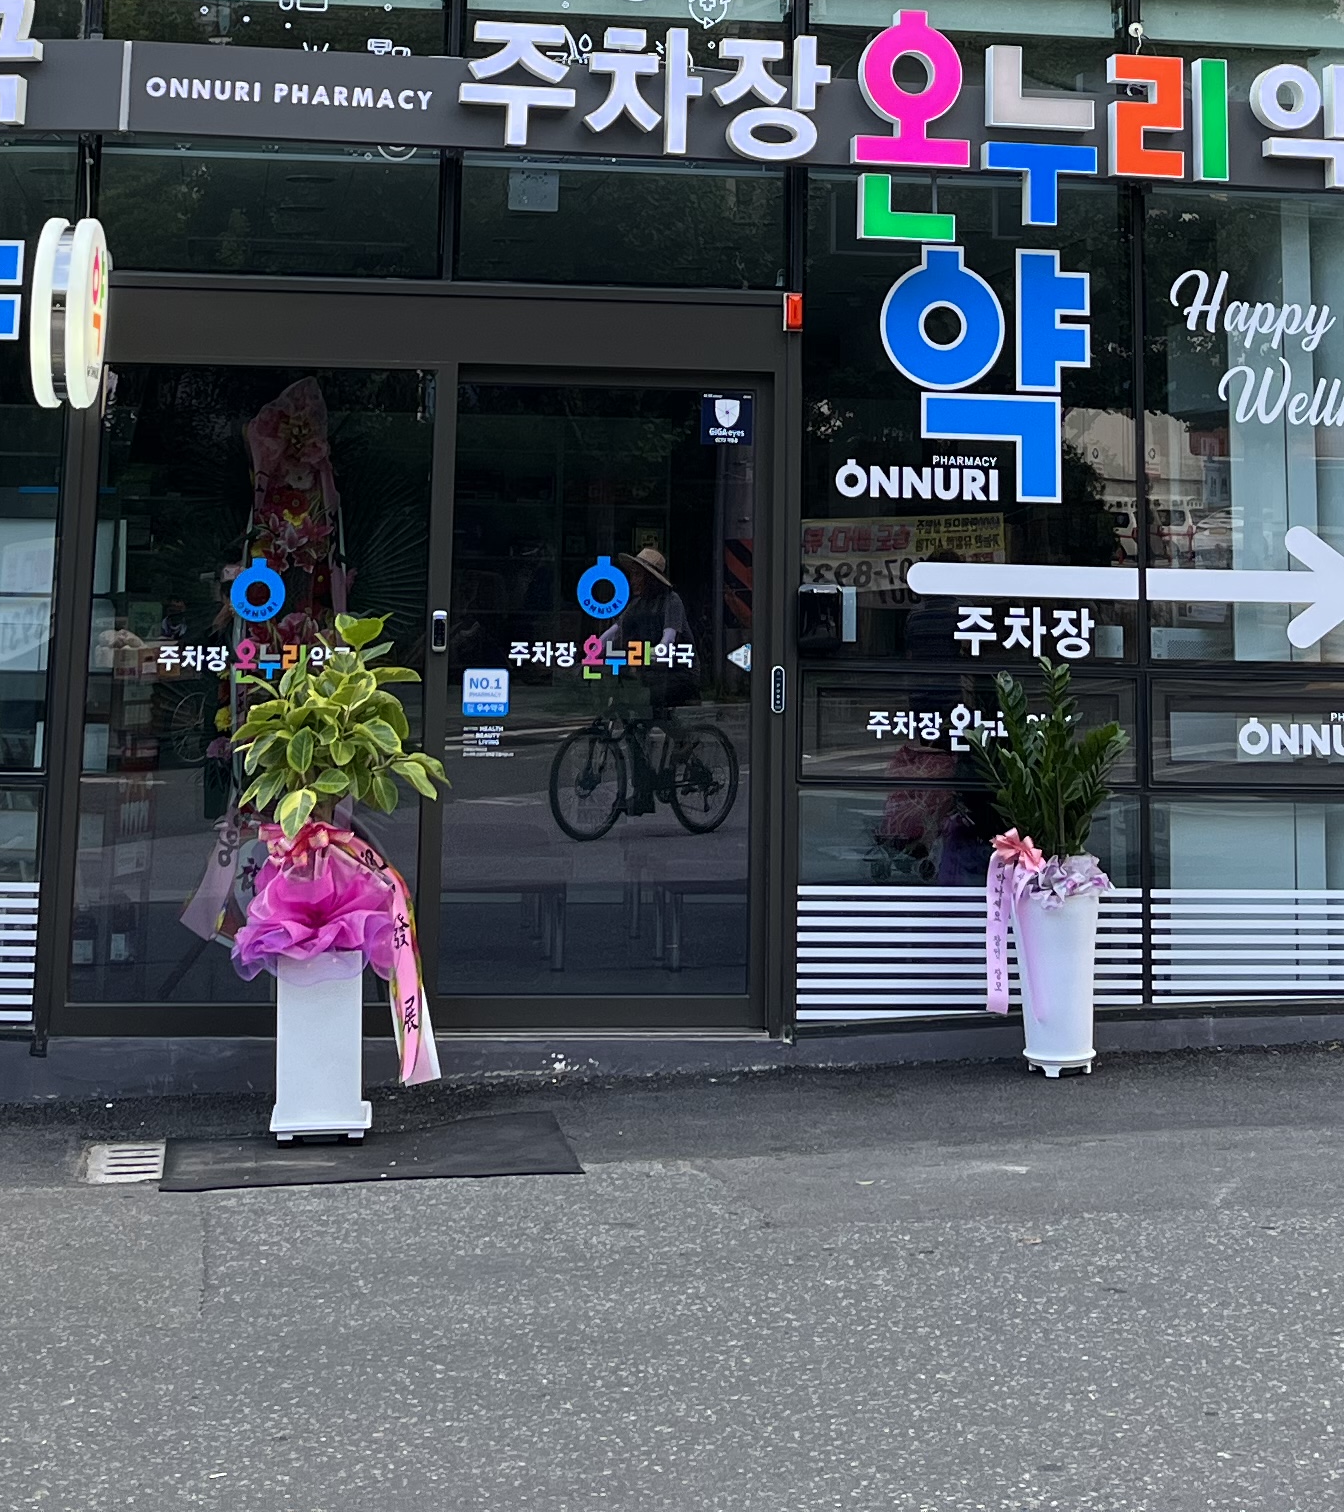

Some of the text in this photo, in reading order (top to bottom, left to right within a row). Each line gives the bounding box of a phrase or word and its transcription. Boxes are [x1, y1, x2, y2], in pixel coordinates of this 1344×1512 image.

[145, 76, 434, 112] ONNURI PHARMACY
[458, 20, 831, 162] 주차장
[1169, 268, 1338, 353] Happy
[879, 244, 1091, 504] 약
[932, 454, 998, 469] PHARMACY
[835, 458, 999, 502] ONNURI
[954, 606, 1096, 660] 주차장
[157, 644, 229, 673] 주차장
[508, 641, 577, 667] 주차장
[655, 643, 695, 668] 약국
[469, 677, 502, 690] NO.1
[866, 710, 943, 740] 주차장
